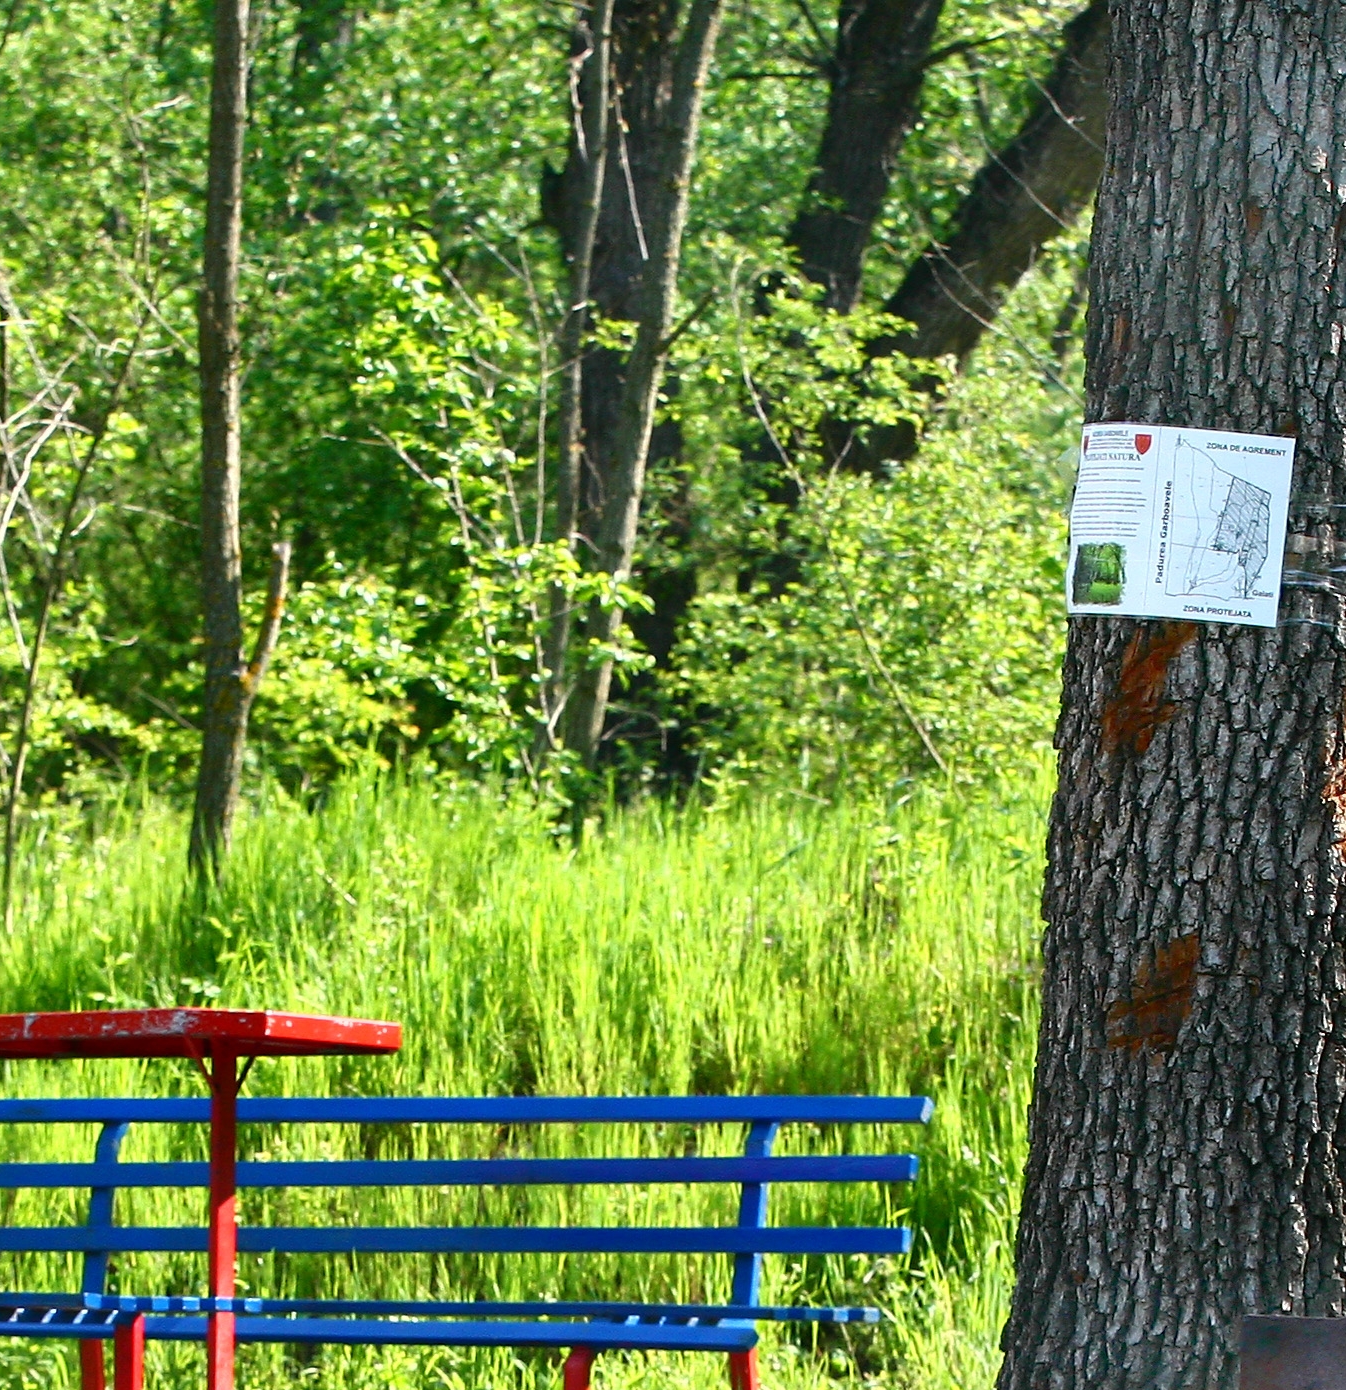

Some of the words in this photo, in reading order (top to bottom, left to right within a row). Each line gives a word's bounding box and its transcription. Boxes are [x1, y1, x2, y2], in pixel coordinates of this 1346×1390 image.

[1206, 442, 1228, 450] ZONA
[1230, 444, 1241, 452] DE
[1242, 446, 1287, 456] AGREMENT
[1160, 480, 1173, 539] Garboavele
[1155, 541, 1166, 584] Padurea
[1183, 605, 1205, 613] ZONA
[1206, 607, 1253, 618] PROTEJATA
